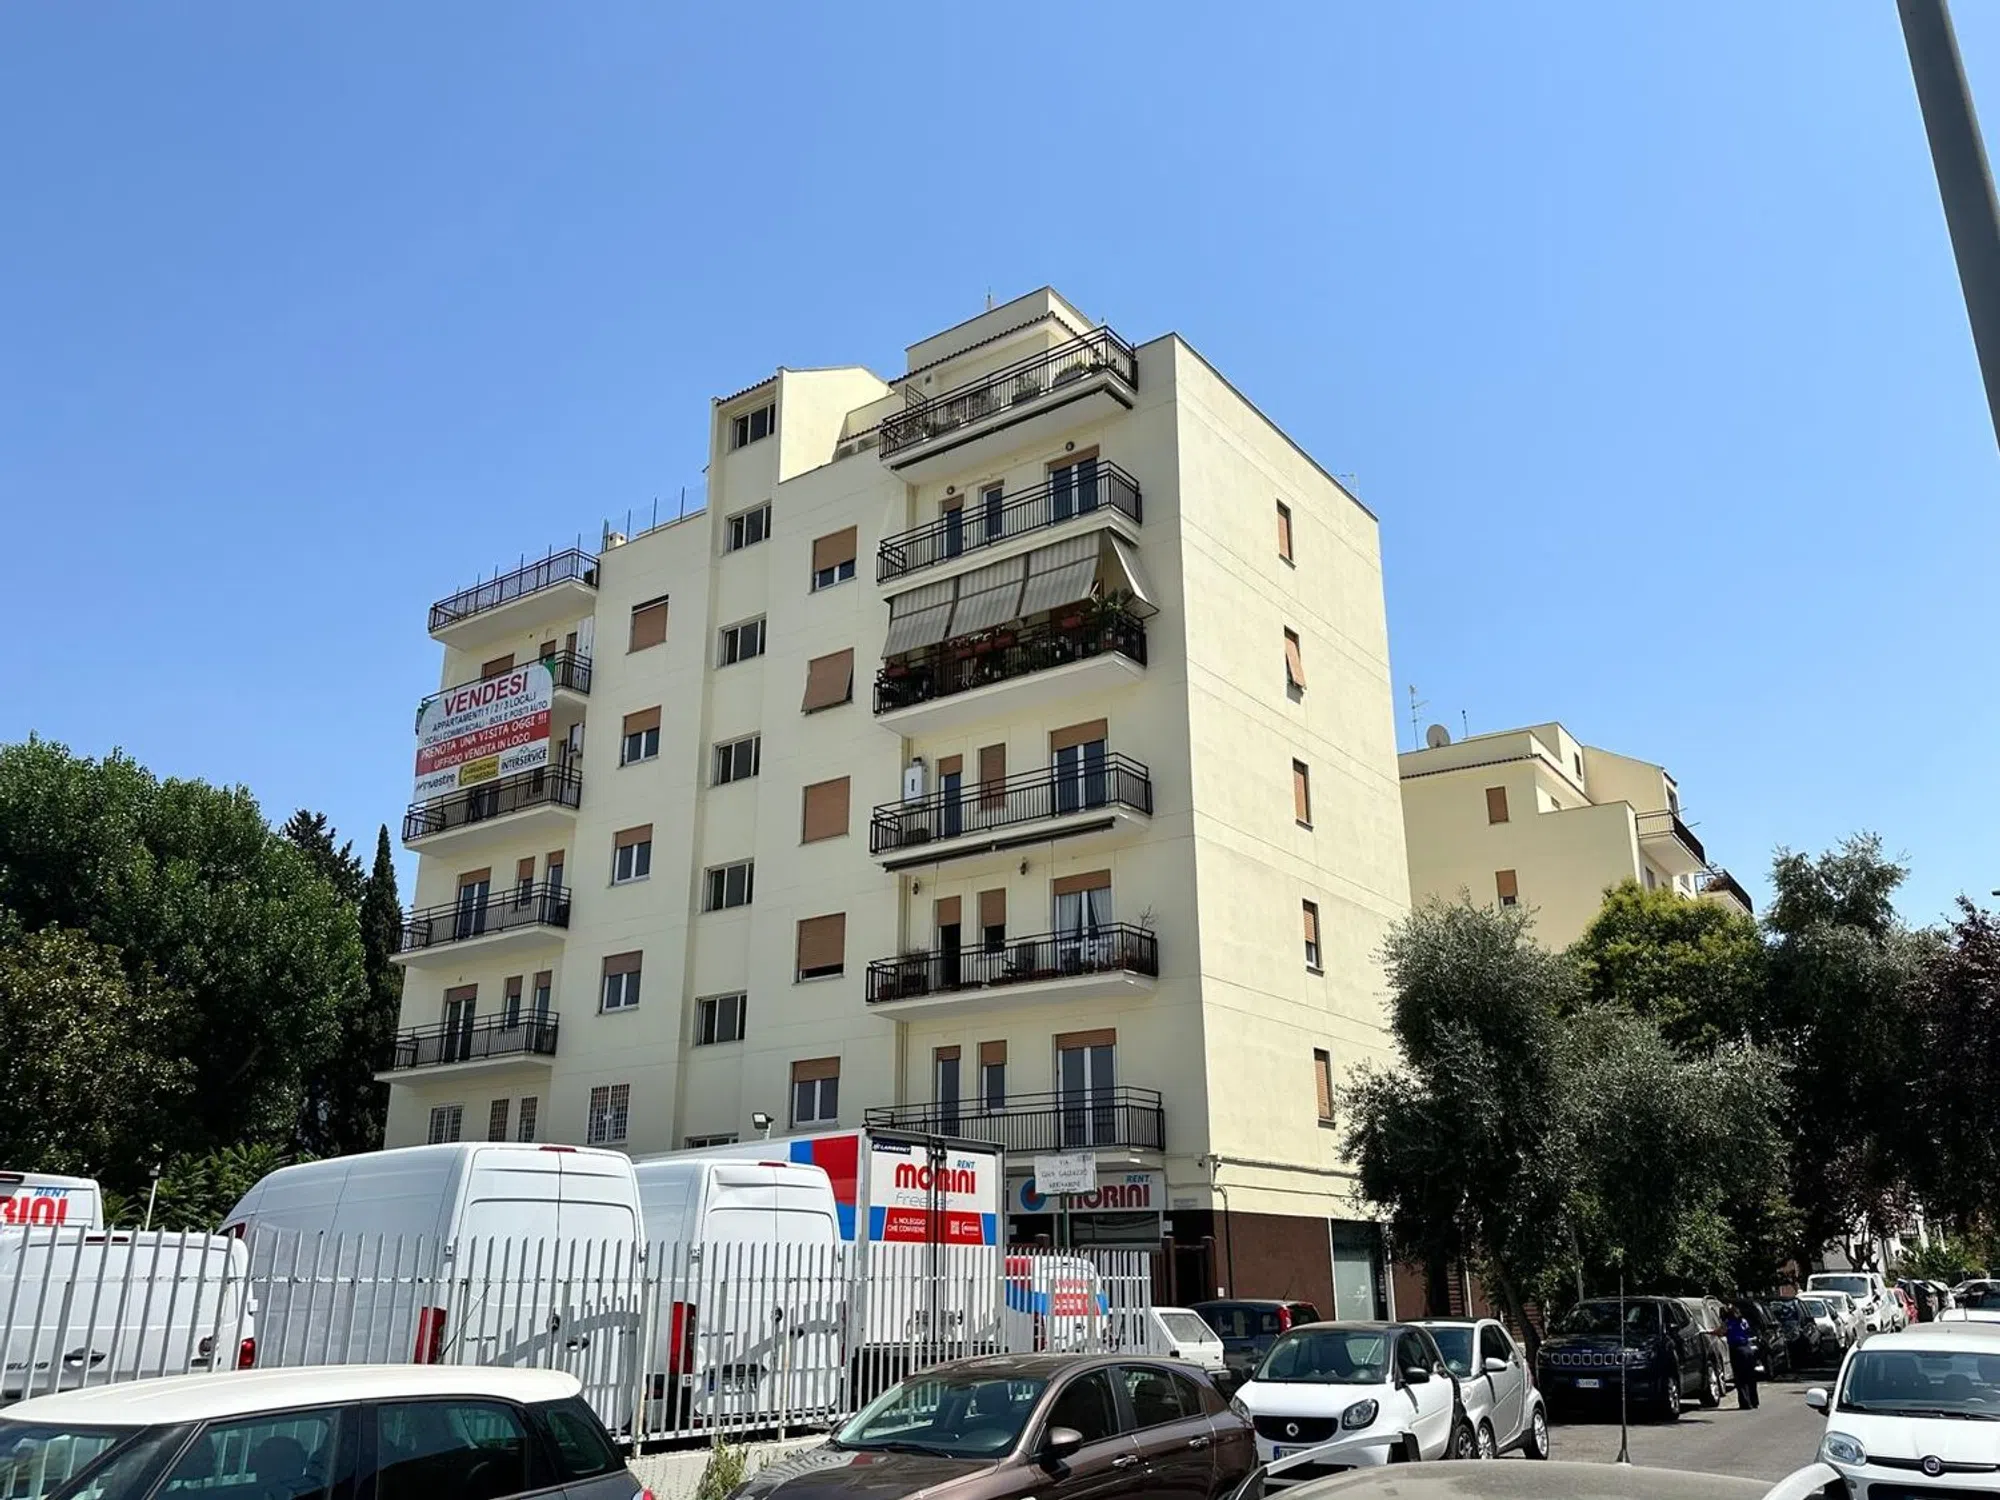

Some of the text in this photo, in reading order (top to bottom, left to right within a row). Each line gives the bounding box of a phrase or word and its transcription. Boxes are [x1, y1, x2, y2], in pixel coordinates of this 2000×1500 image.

[445, 671, 528, 716] VENDESI
[432, 708, 483, 731] APPARTAMENTI
[510, 692, 535, 707] LOCALI
[443, 719, 484, 738] COMMERCIALI
[489, 714, 501, 724] BOX
[509, 706, 528, 718] POSTI
[530, 700, 547, 711] AUTO
[421, 741, 455, 759] PRENOTA
[460, 734, 476, 747] UNA
[478, 724, 508, 741] VISITA
[511, 716, 534, 731] OGGI
[434, 731, 530, 768] UFFICIO VENDITA IN LOCO
[502, 748, 547, 770] INTERSERVICE
[895, 1162, 976, 1194] MORINI
[956, 1160, 976, 1169] RENT
[1126, 1175, 1150, 1184] RENT
[34, 1187, 70, 1197] RENT
[1060, 1184, 1149, 1209] MORINI
